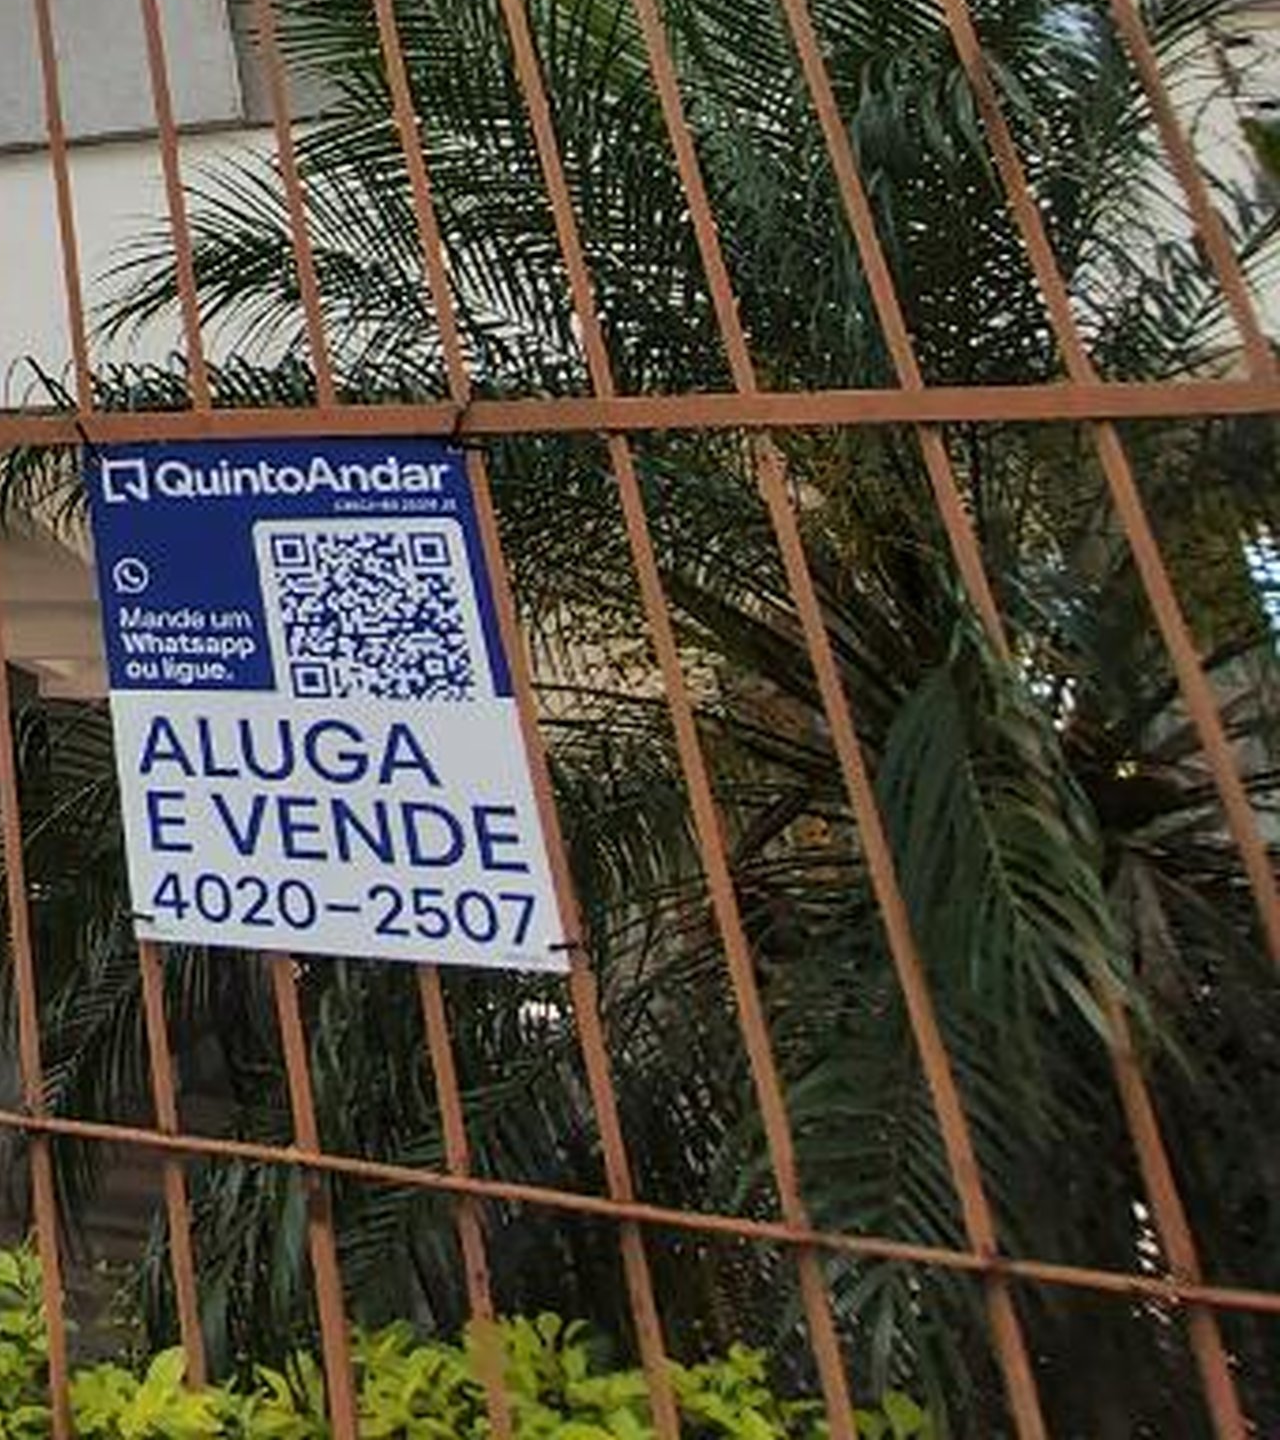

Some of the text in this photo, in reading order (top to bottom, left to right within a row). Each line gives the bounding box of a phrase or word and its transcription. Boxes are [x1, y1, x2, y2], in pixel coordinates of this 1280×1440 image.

[155, 456, 449, 498] QuintoAndar
[210, 610, 253, 629] um
[122, 633, 255, 659] Whatsapp
[126, 661, 159, 679] ou
[140, 716, 442, 787] ALUGA
[147, 790, 530, 873] E VENDE
[152, 872, 536, 945] 4020-2507
